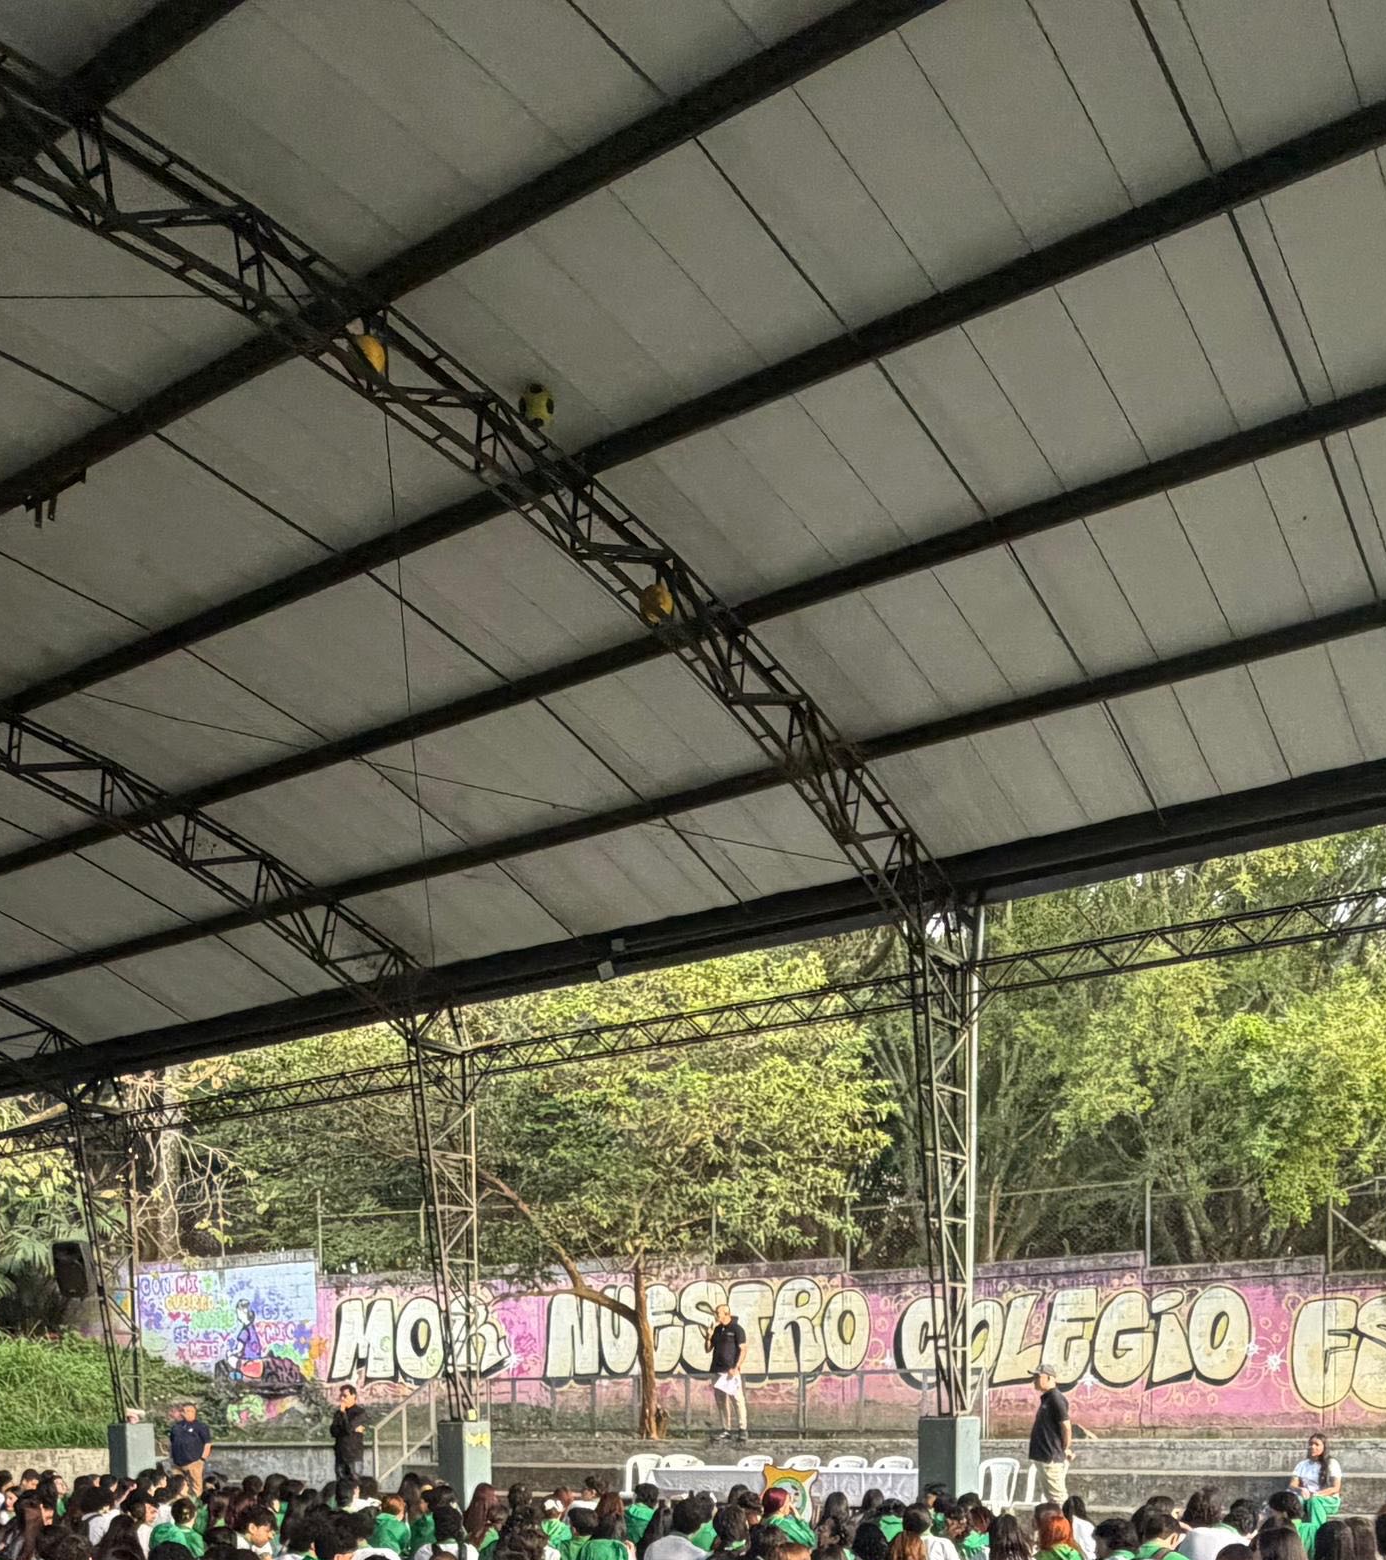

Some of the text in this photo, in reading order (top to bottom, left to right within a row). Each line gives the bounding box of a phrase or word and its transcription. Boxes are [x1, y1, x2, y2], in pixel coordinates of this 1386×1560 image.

[140, 1275, 198, 1297] CON MI
[174, 1325, 190, 1343] SE
[543, 1276, 871, 1384] NUESTRO
